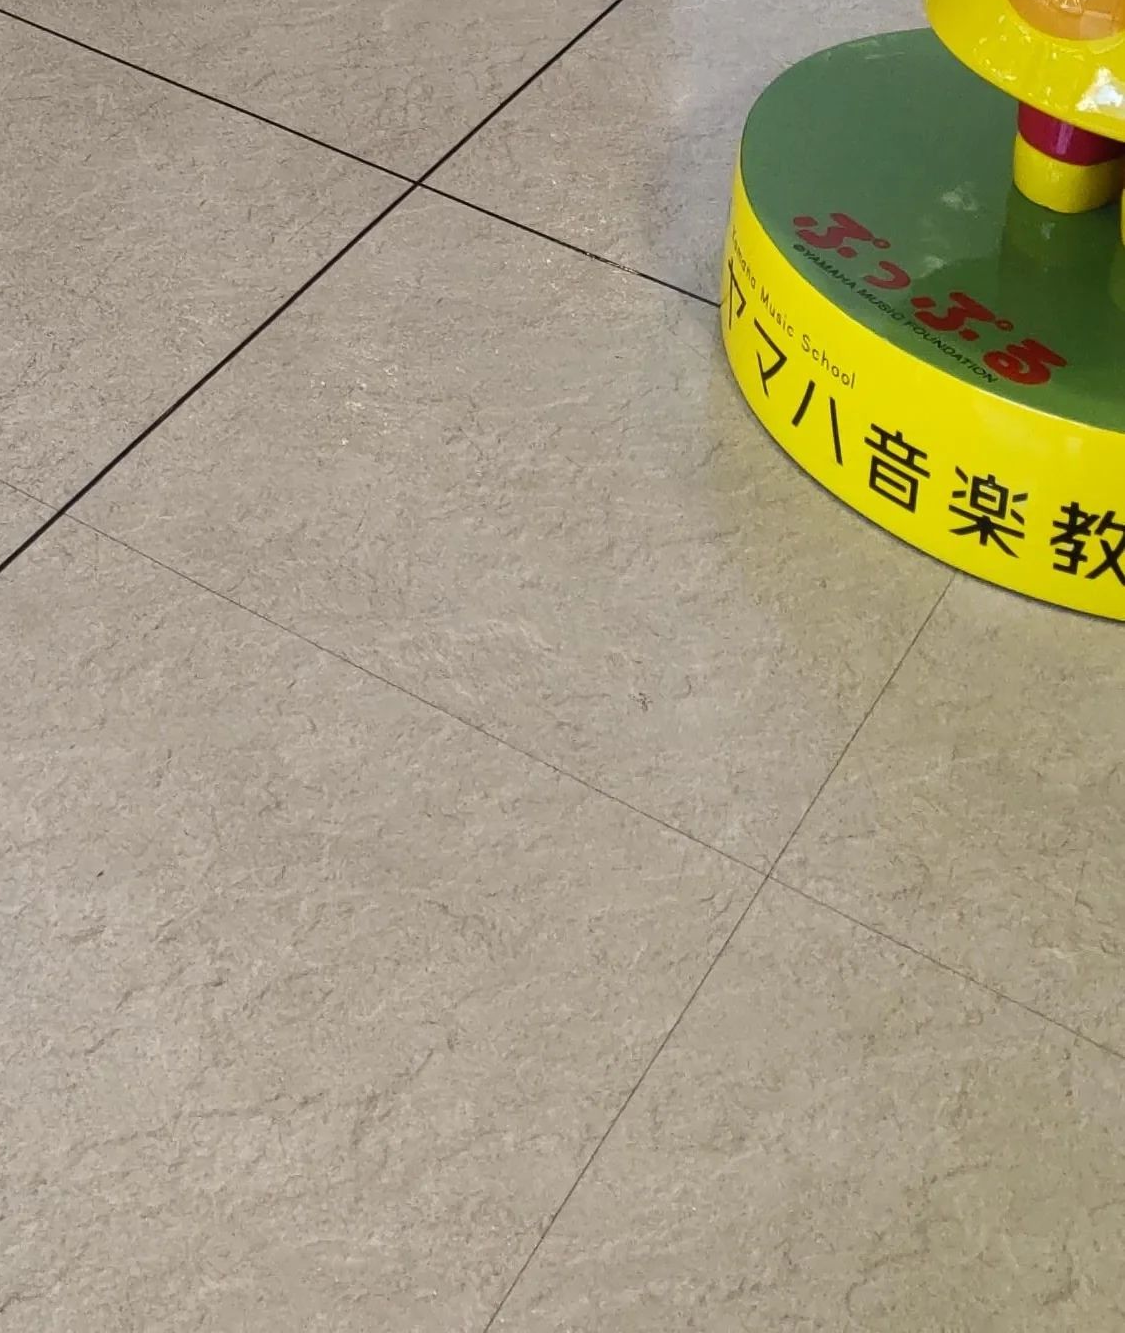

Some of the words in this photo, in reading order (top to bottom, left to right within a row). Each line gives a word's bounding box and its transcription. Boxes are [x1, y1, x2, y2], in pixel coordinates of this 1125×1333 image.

[760, 286, 795, 338] Music
[801, 334, 856, 389] School
[857, 288, 905, 321] MUSIC
[904, 320, 998, 383] FOUNDATION
